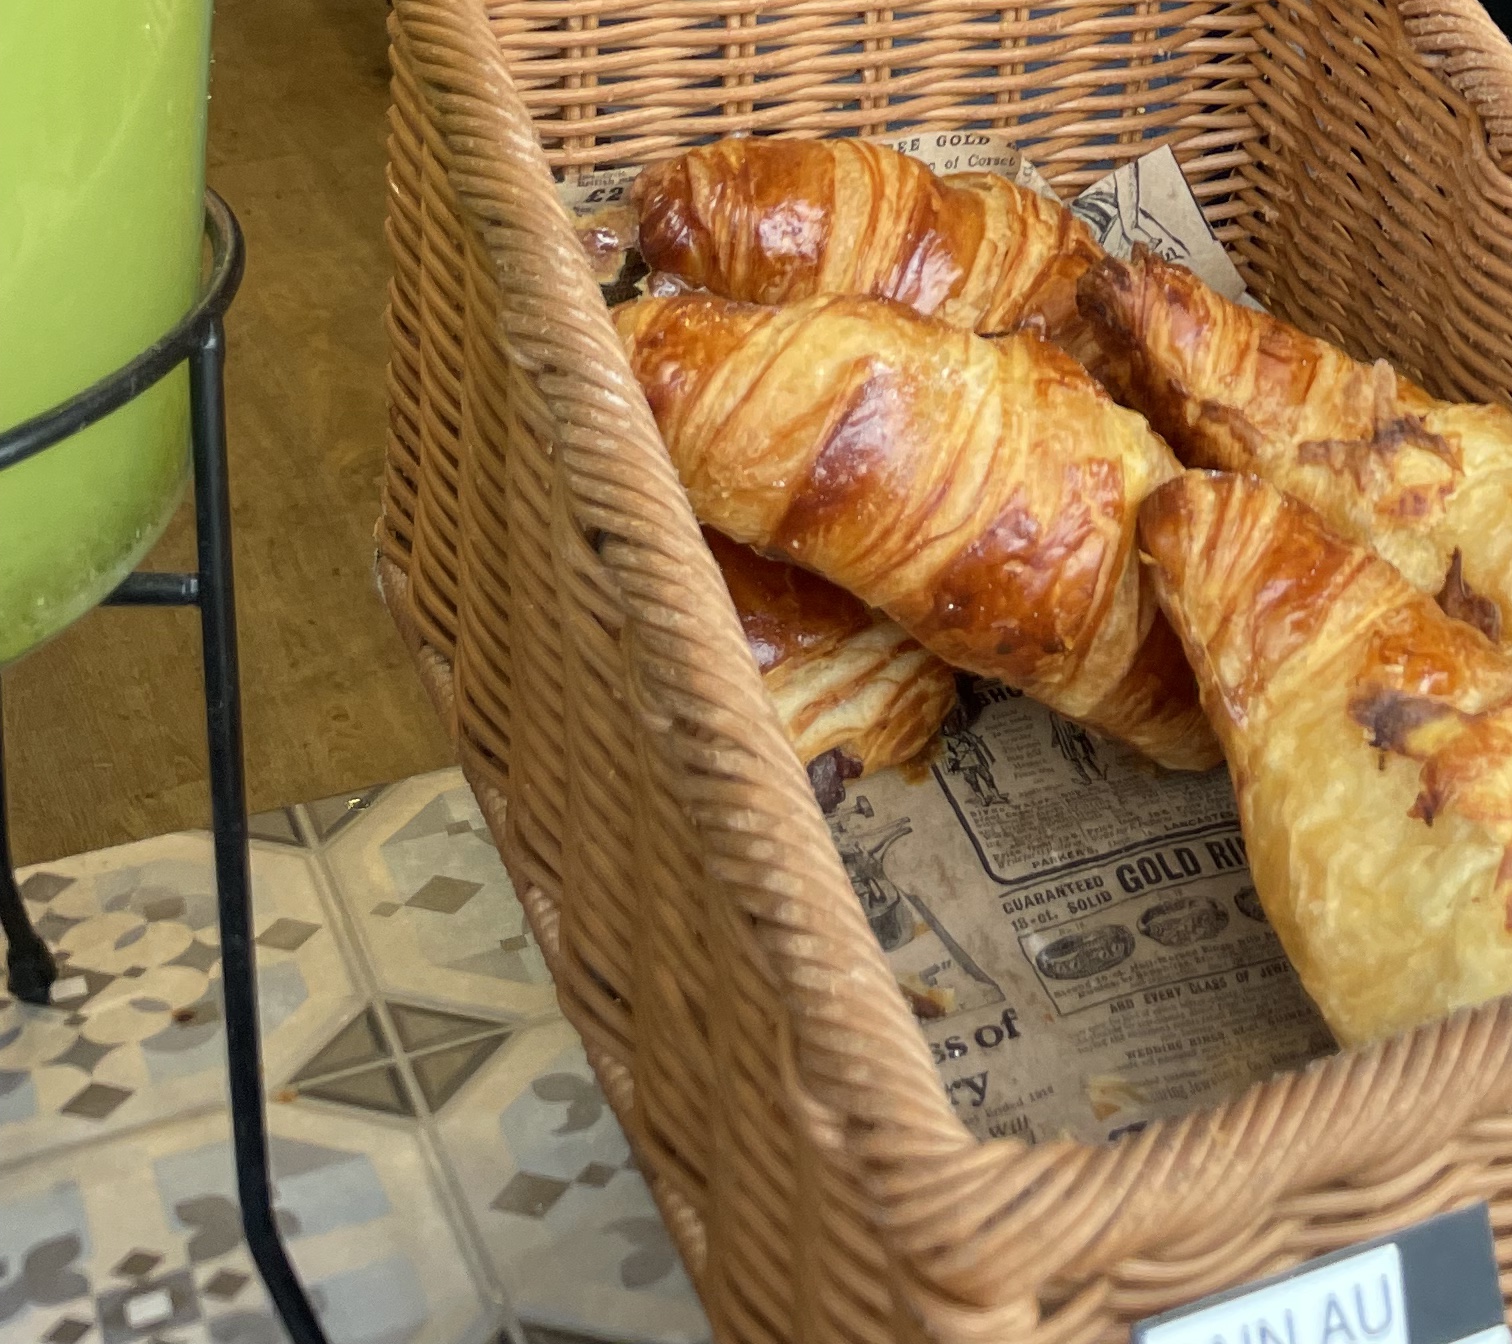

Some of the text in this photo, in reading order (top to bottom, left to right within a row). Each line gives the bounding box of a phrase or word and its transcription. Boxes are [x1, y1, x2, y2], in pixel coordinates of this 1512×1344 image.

[936, 134, 991, 149] GOLD
[1002, 875, 1105, 915] GUARANTEED
[1116, 847, 1203, 894] GOLD
[1067, 890, 1113, 915] SOLID
[974, 1008, 1021, 1048] of
